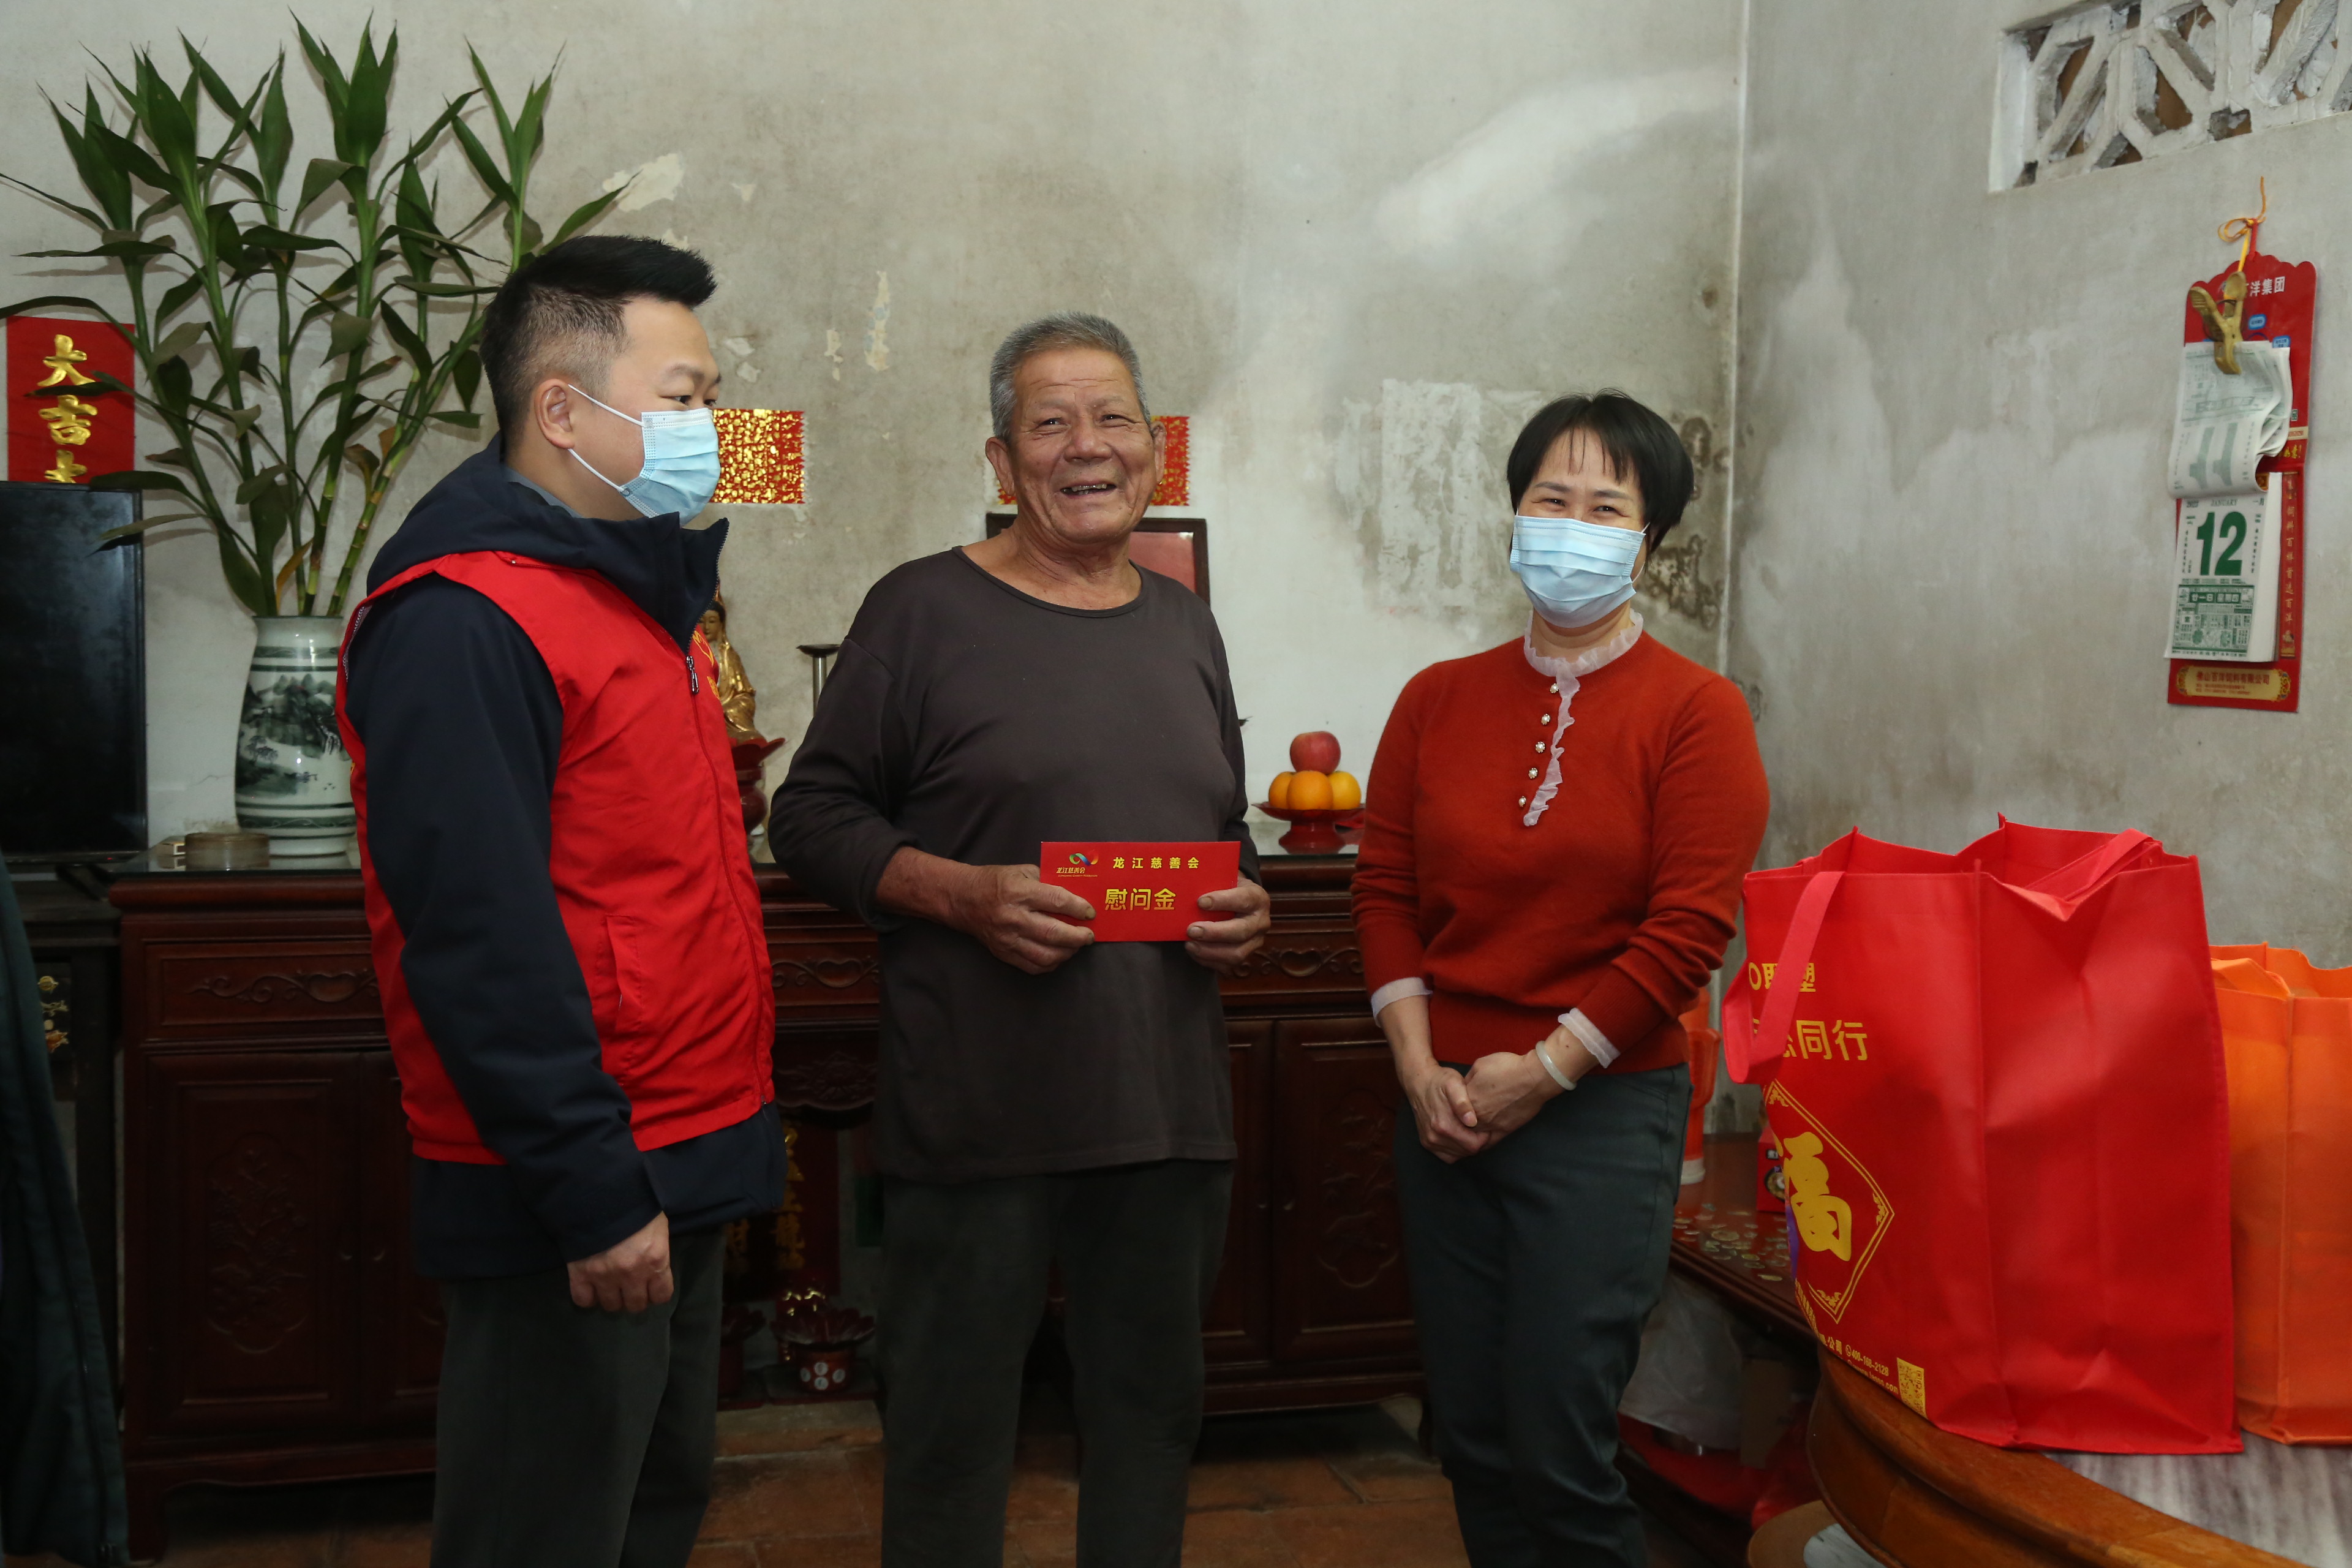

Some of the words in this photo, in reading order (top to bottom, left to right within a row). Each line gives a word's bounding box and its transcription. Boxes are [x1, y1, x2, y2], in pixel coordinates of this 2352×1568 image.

[2246, 276, 2286, 297] 洋集团
[2196, 511, 2247, 576] 12
[1112, 857, 1199, 869] 龙江慈善会
[1104, 888, 1177, 911] 慰问金
[1753, 1019, 1868, 1061] 同行
